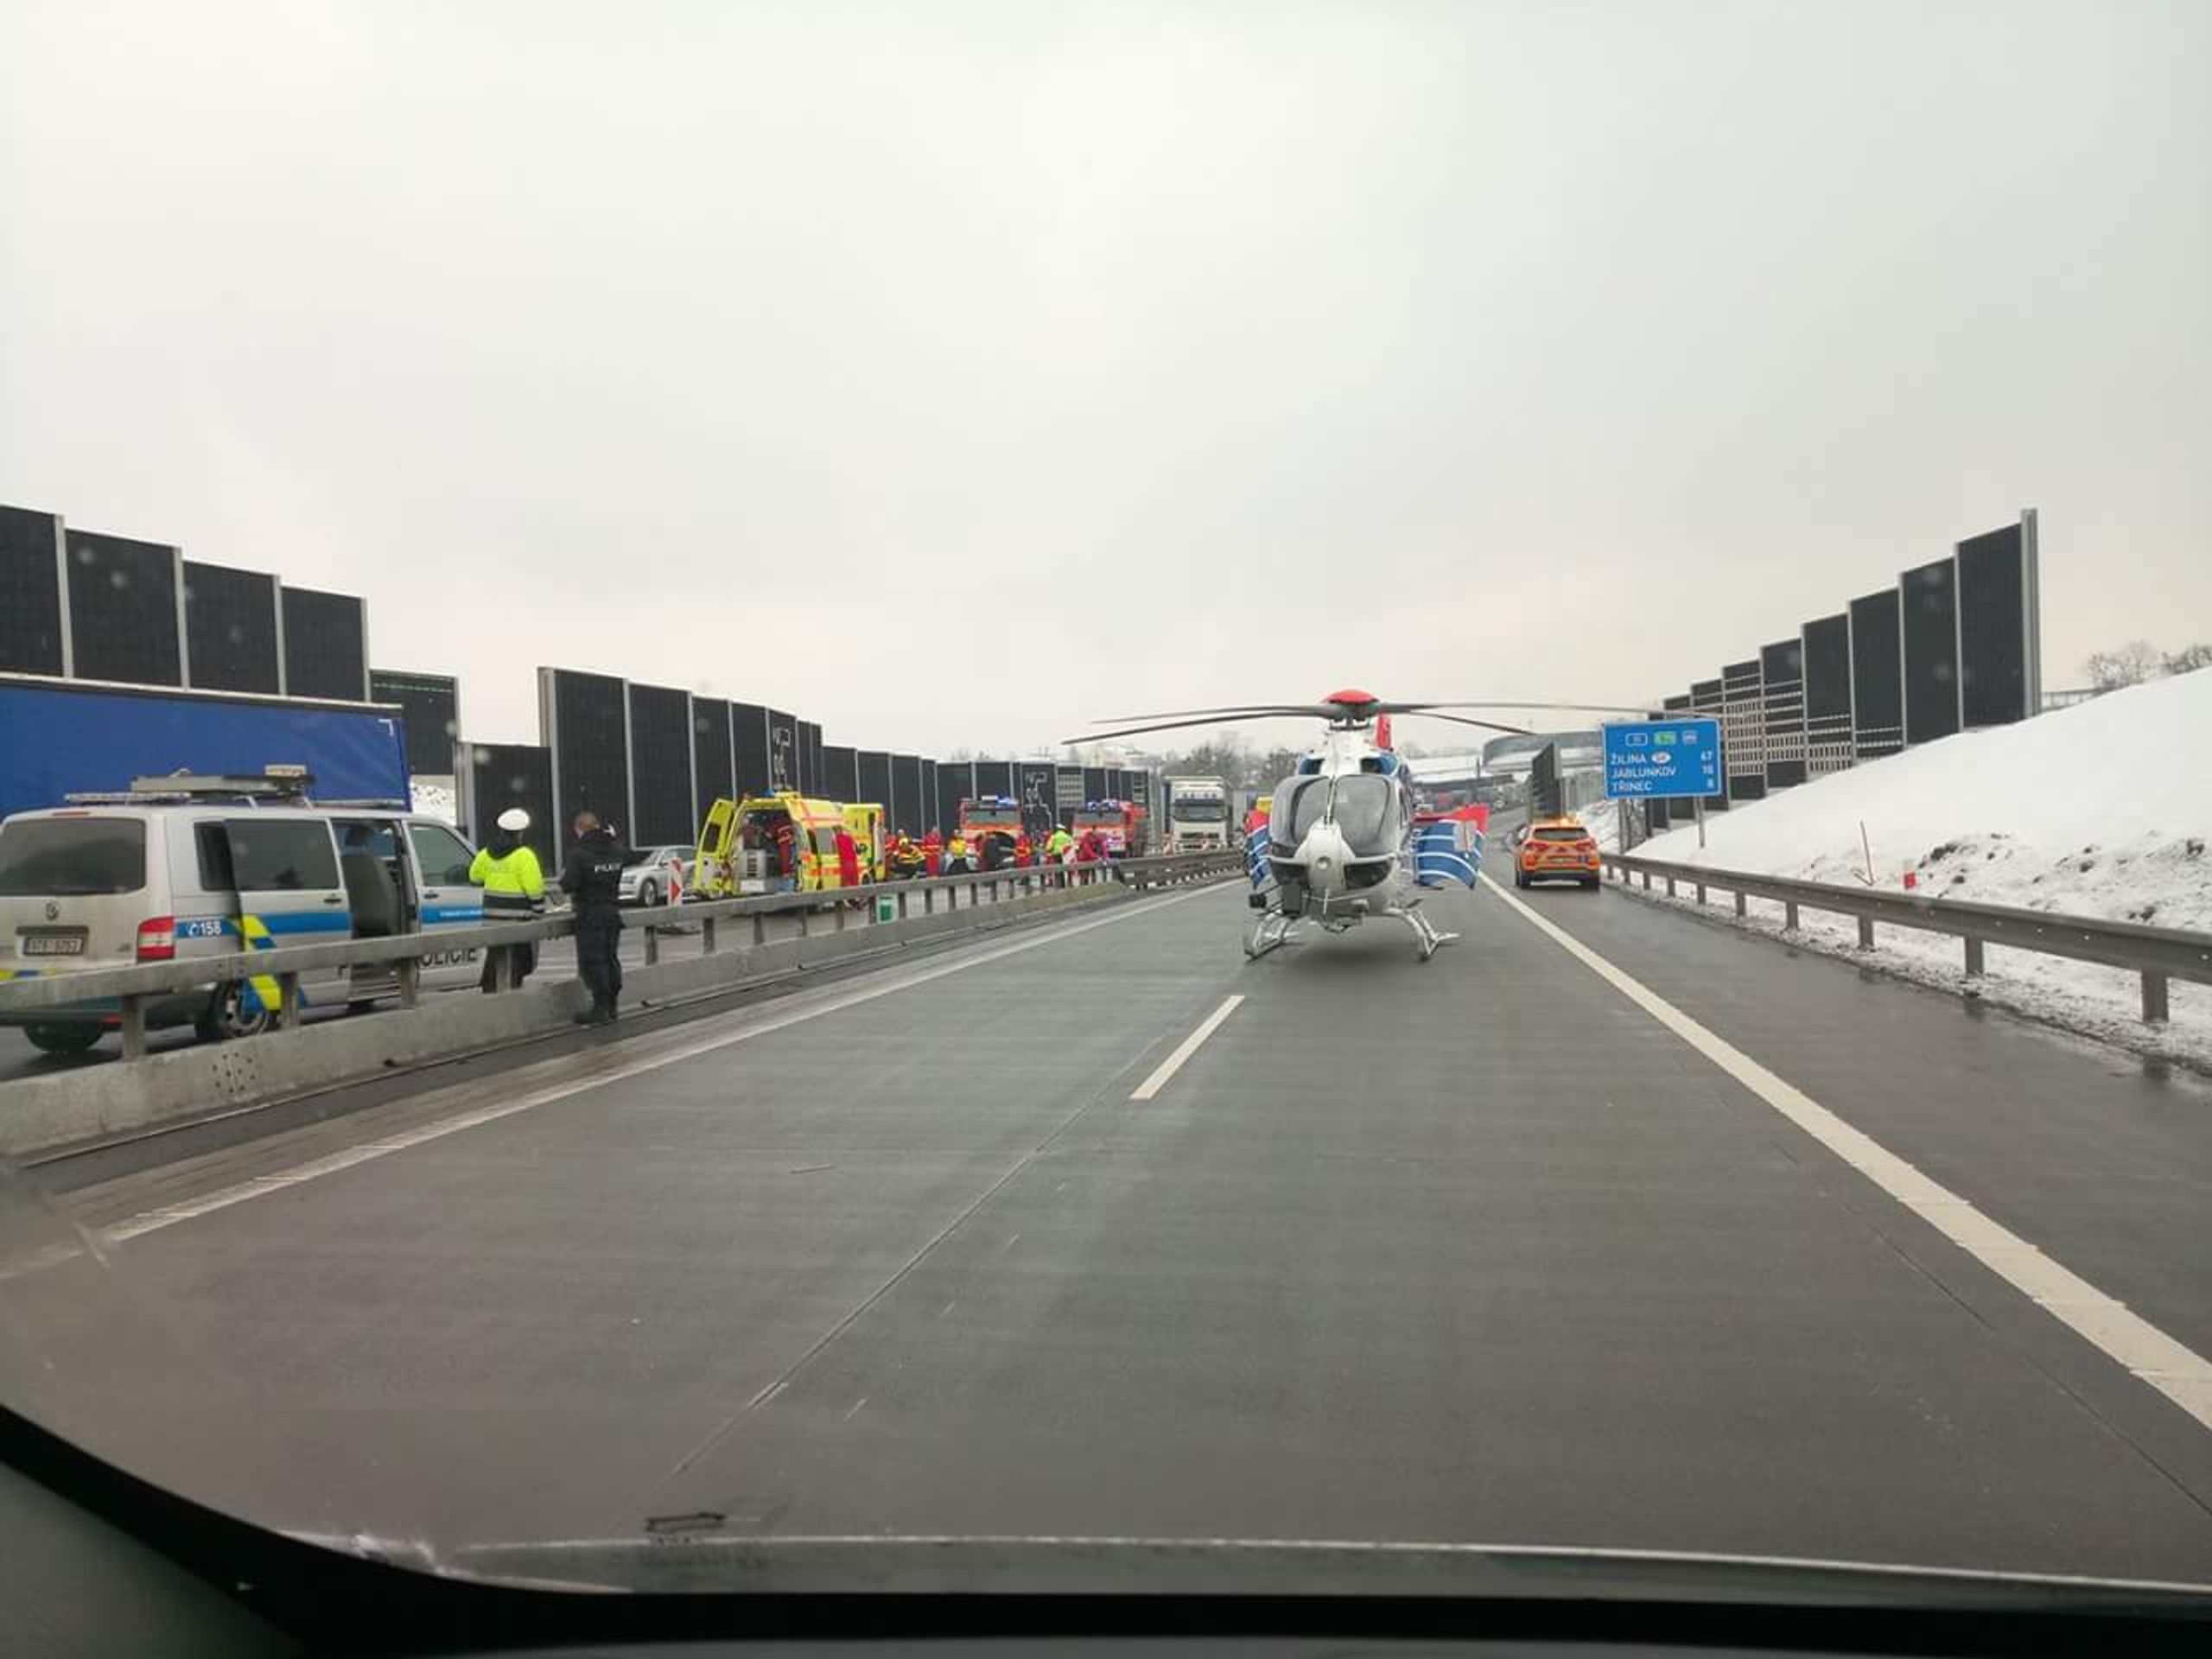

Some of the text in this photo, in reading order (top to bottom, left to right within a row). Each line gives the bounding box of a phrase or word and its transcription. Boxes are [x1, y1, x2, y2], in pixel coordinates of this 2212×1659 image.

[1700, 750, 1713, 761] 67
[1612, 766, 1676, 779] JABLUNKOV
[200, 921, 222, 935] 158
